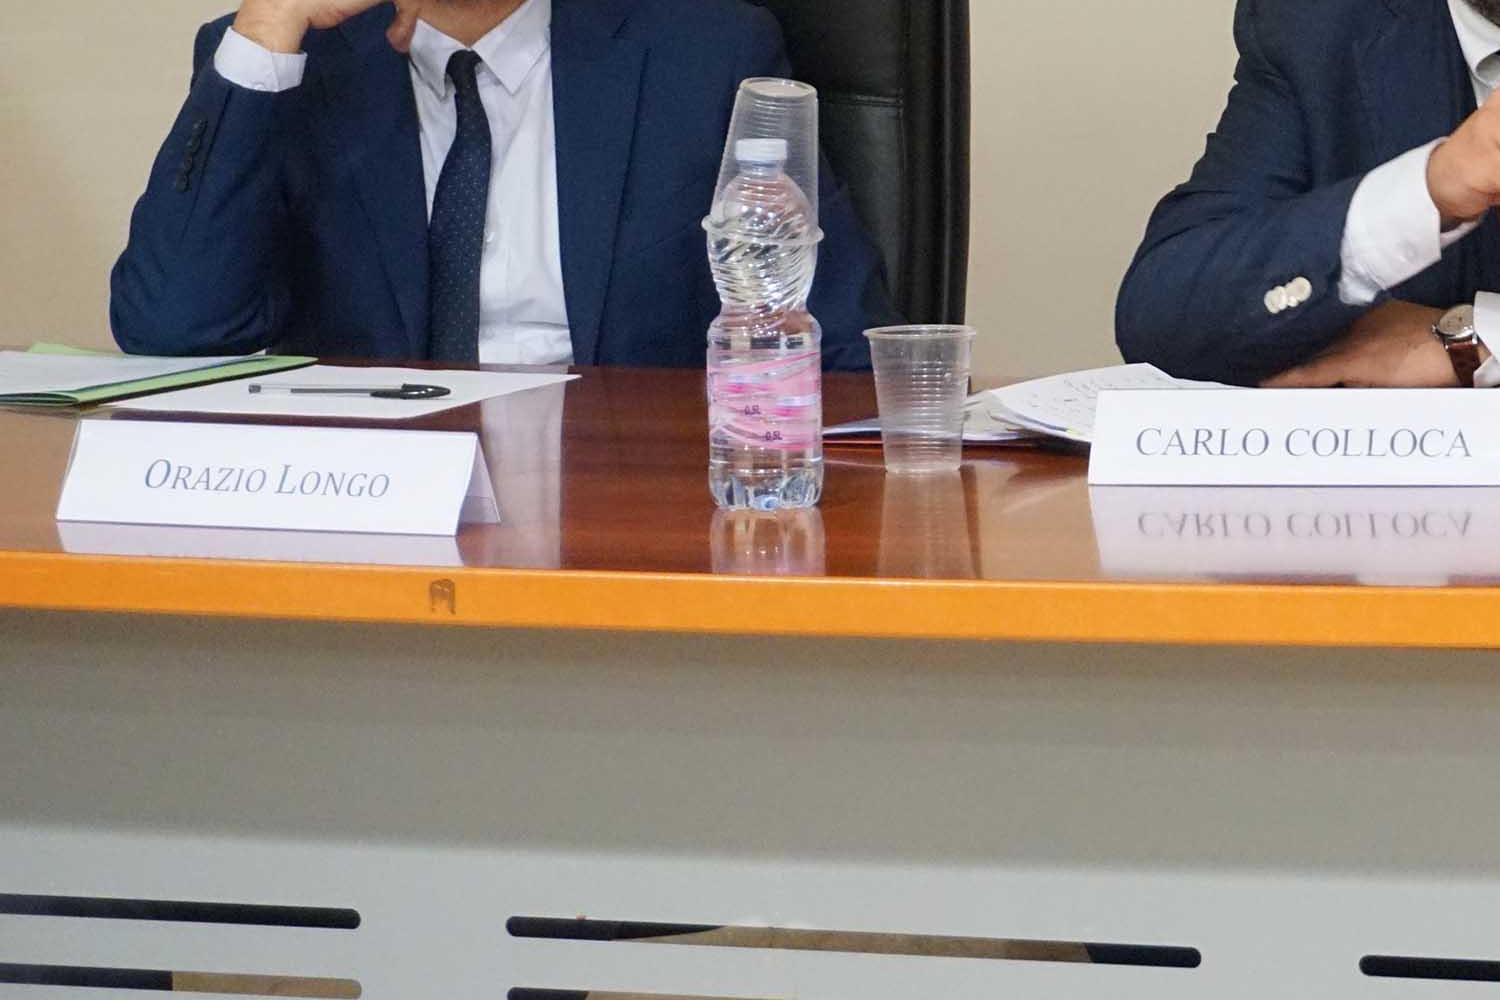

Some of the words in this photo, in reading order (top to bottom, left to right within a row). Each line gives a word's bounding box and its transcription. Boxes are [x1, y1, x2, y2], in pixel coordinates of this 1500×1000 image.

[1135, 427, 1270, 457] CARLO
[1284, 427, 1473, 458] COLLOCA
[143, 458, 267, 493] ORAZIO
[274, 463, 390, 498] LONGO
